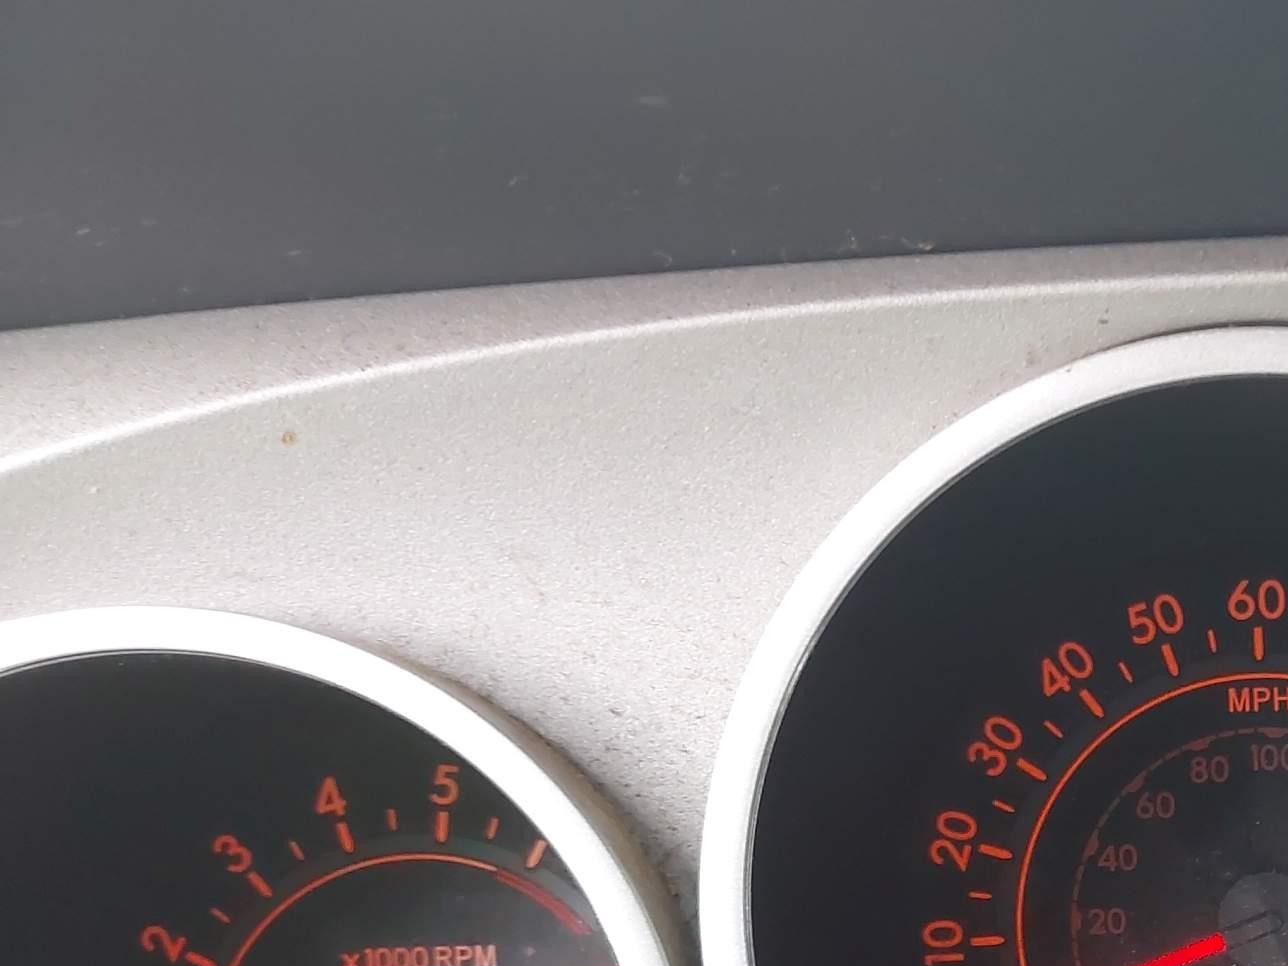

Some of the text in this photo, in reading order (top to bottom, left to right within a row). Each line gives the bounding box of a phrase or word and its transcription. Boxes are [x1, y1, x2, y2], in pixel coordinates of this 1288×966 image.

[1127, 593, 1185, 646] 50
[1227, 579, 1286, 621] 60
[1040, 640, 1095, 698] 40
[967, 715, 1024, 775] 30
[429, 764, 460, 806] 5
[1190, 756, 1229, 783] 80
[313, 776, 346, 816] 4
[1135, 792, 1176, 819] 60
[211, 834, 252, 874] 3
[929, 810, 977, 870] 20
[1097, 844, 1138, 871] 40
[1088, 908, 1126, 934] 20
[139, 925, 186, 963] 2
[924, 919, 964, 966] 10
